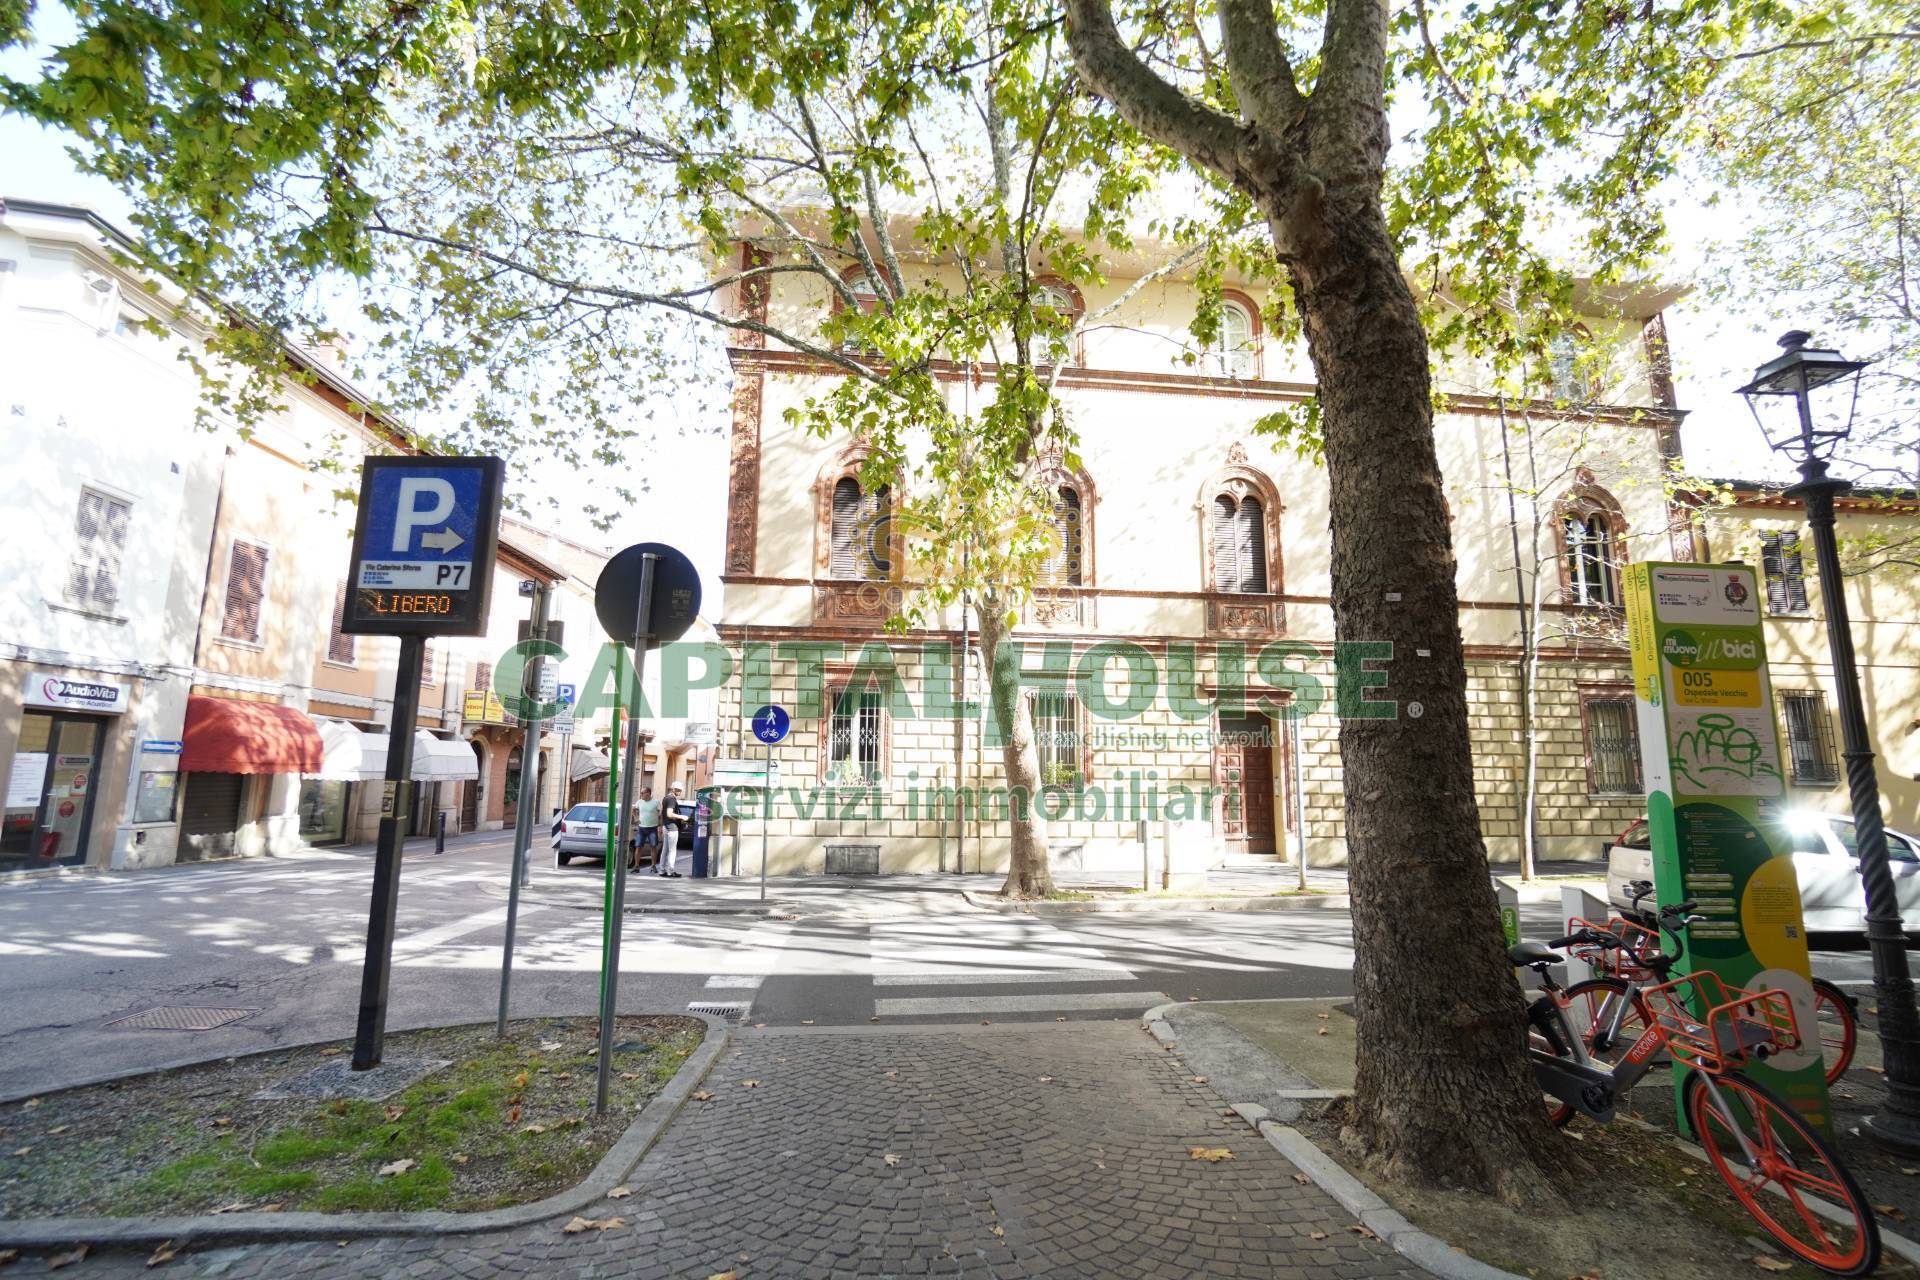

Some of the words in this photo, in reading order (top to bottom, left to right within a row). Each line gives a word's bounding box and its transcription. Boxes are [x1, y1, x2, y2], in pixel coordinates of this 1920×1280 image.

[392, 477, 456, 552] P
[436, 564, 466, 586] P7
[1638, 568, 1647, 591] 005
[375, 594, 451, 614] LIBERO
[1665, 636, 1677, 646] mi
[1722, 639, 1757, 660] bici
[1682, 671, 1713, 687] 005
[64, 684, 116, 699] AudioVita
[560, 686, 573, 702] P
[1683, 688, 1718, 698] Ospedale
[1719, 688, 1748, 697] Vecchio
